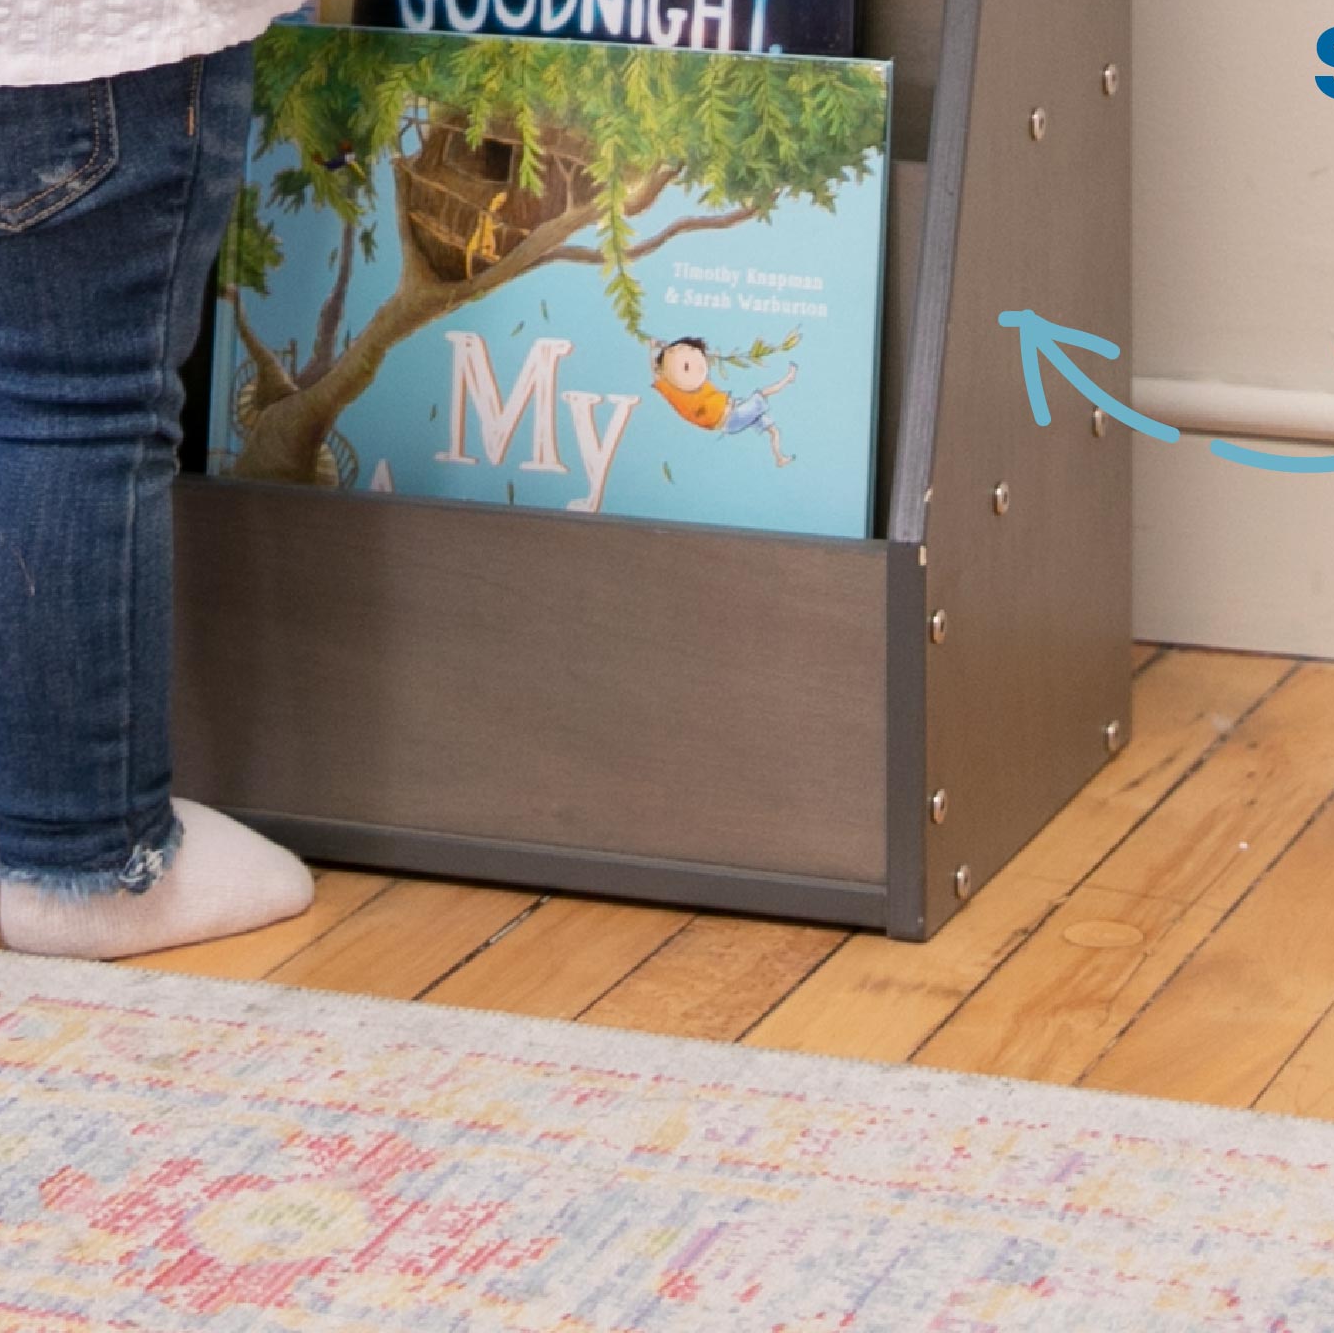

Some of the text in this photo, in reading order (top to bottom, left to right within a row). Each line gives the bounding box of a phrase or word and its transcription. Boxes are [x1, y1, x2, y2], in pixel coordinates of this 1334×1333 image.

[672, 261, 740, 288] Timothy
[683, 288, 732, 309] Sarah
[737, 293, 828, 318] Warburton
[433, 331, 642, 513] My
